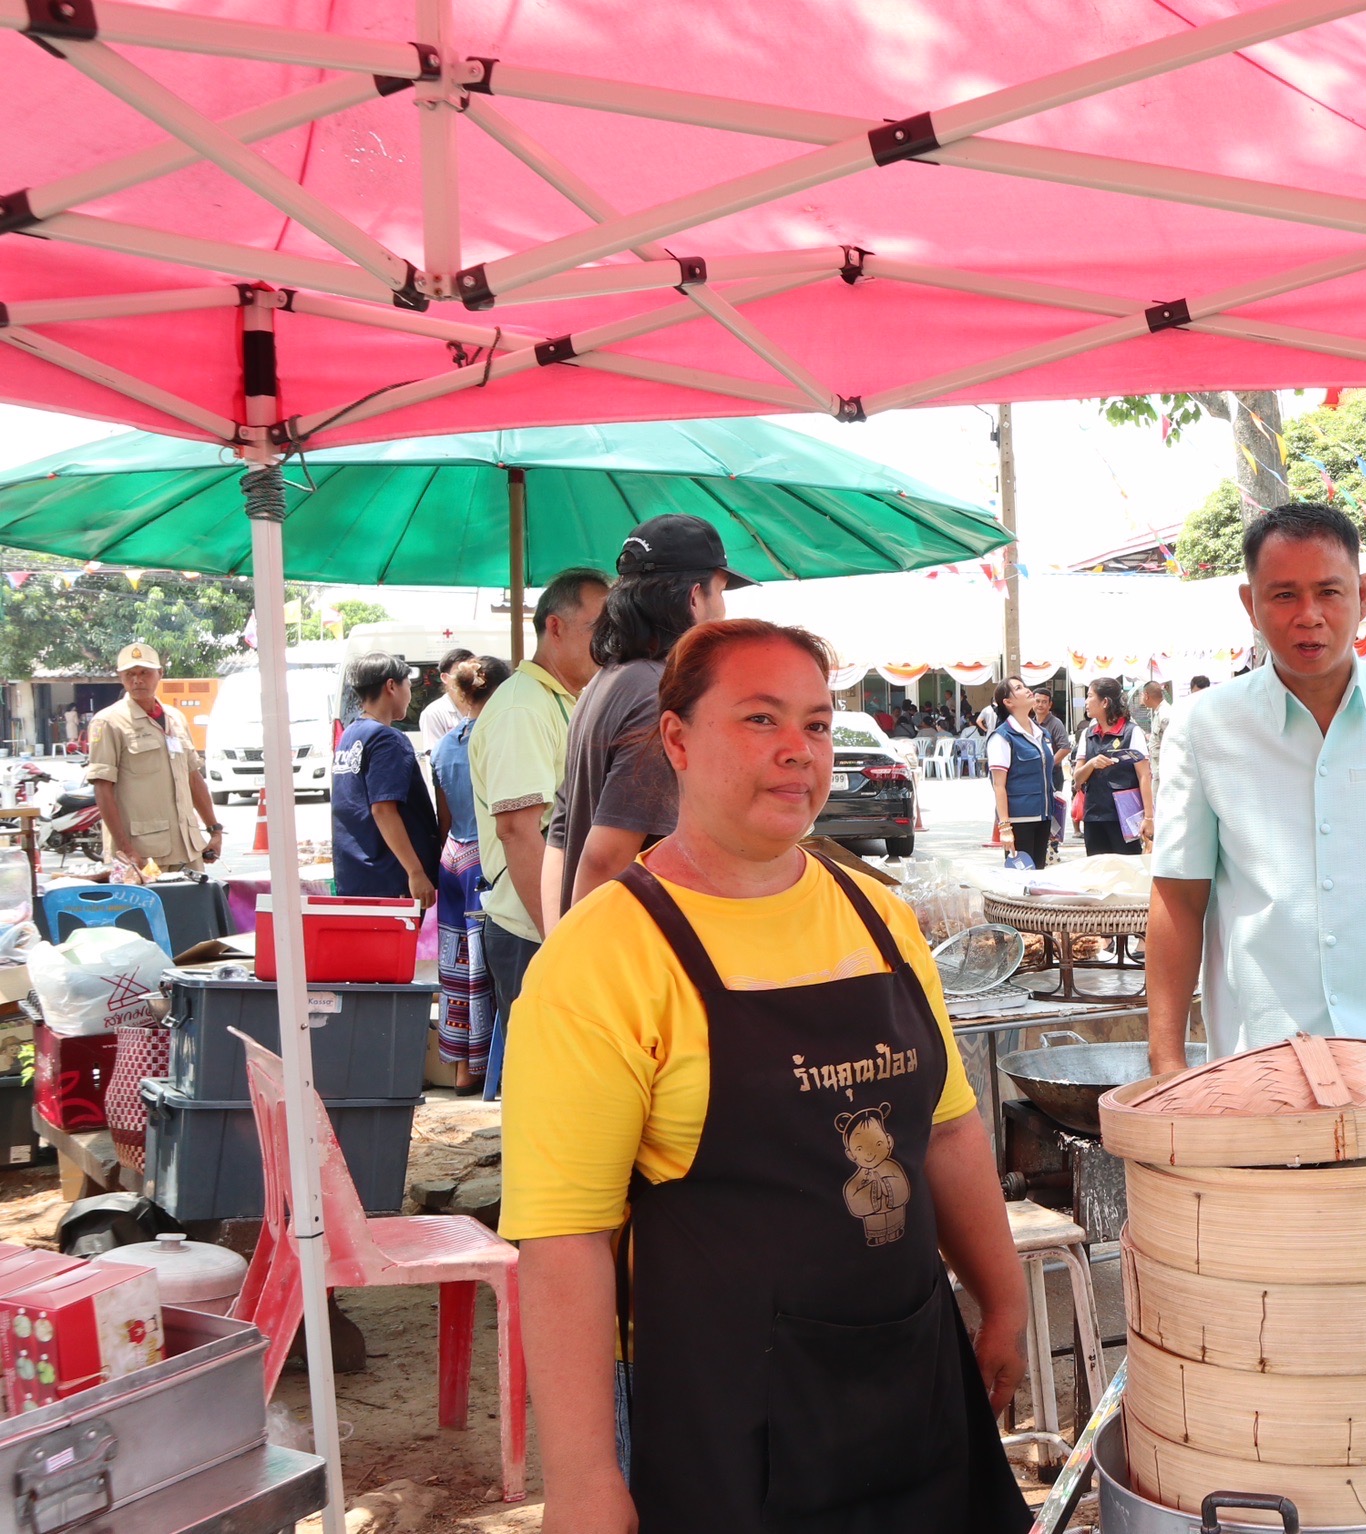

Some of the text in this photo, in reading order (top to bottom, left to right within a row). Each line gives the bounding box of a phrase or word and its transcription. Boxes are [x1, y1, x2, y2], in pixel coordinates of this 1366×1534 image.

[792, 1043, 918, 1103] ร้านคุณป้อม
